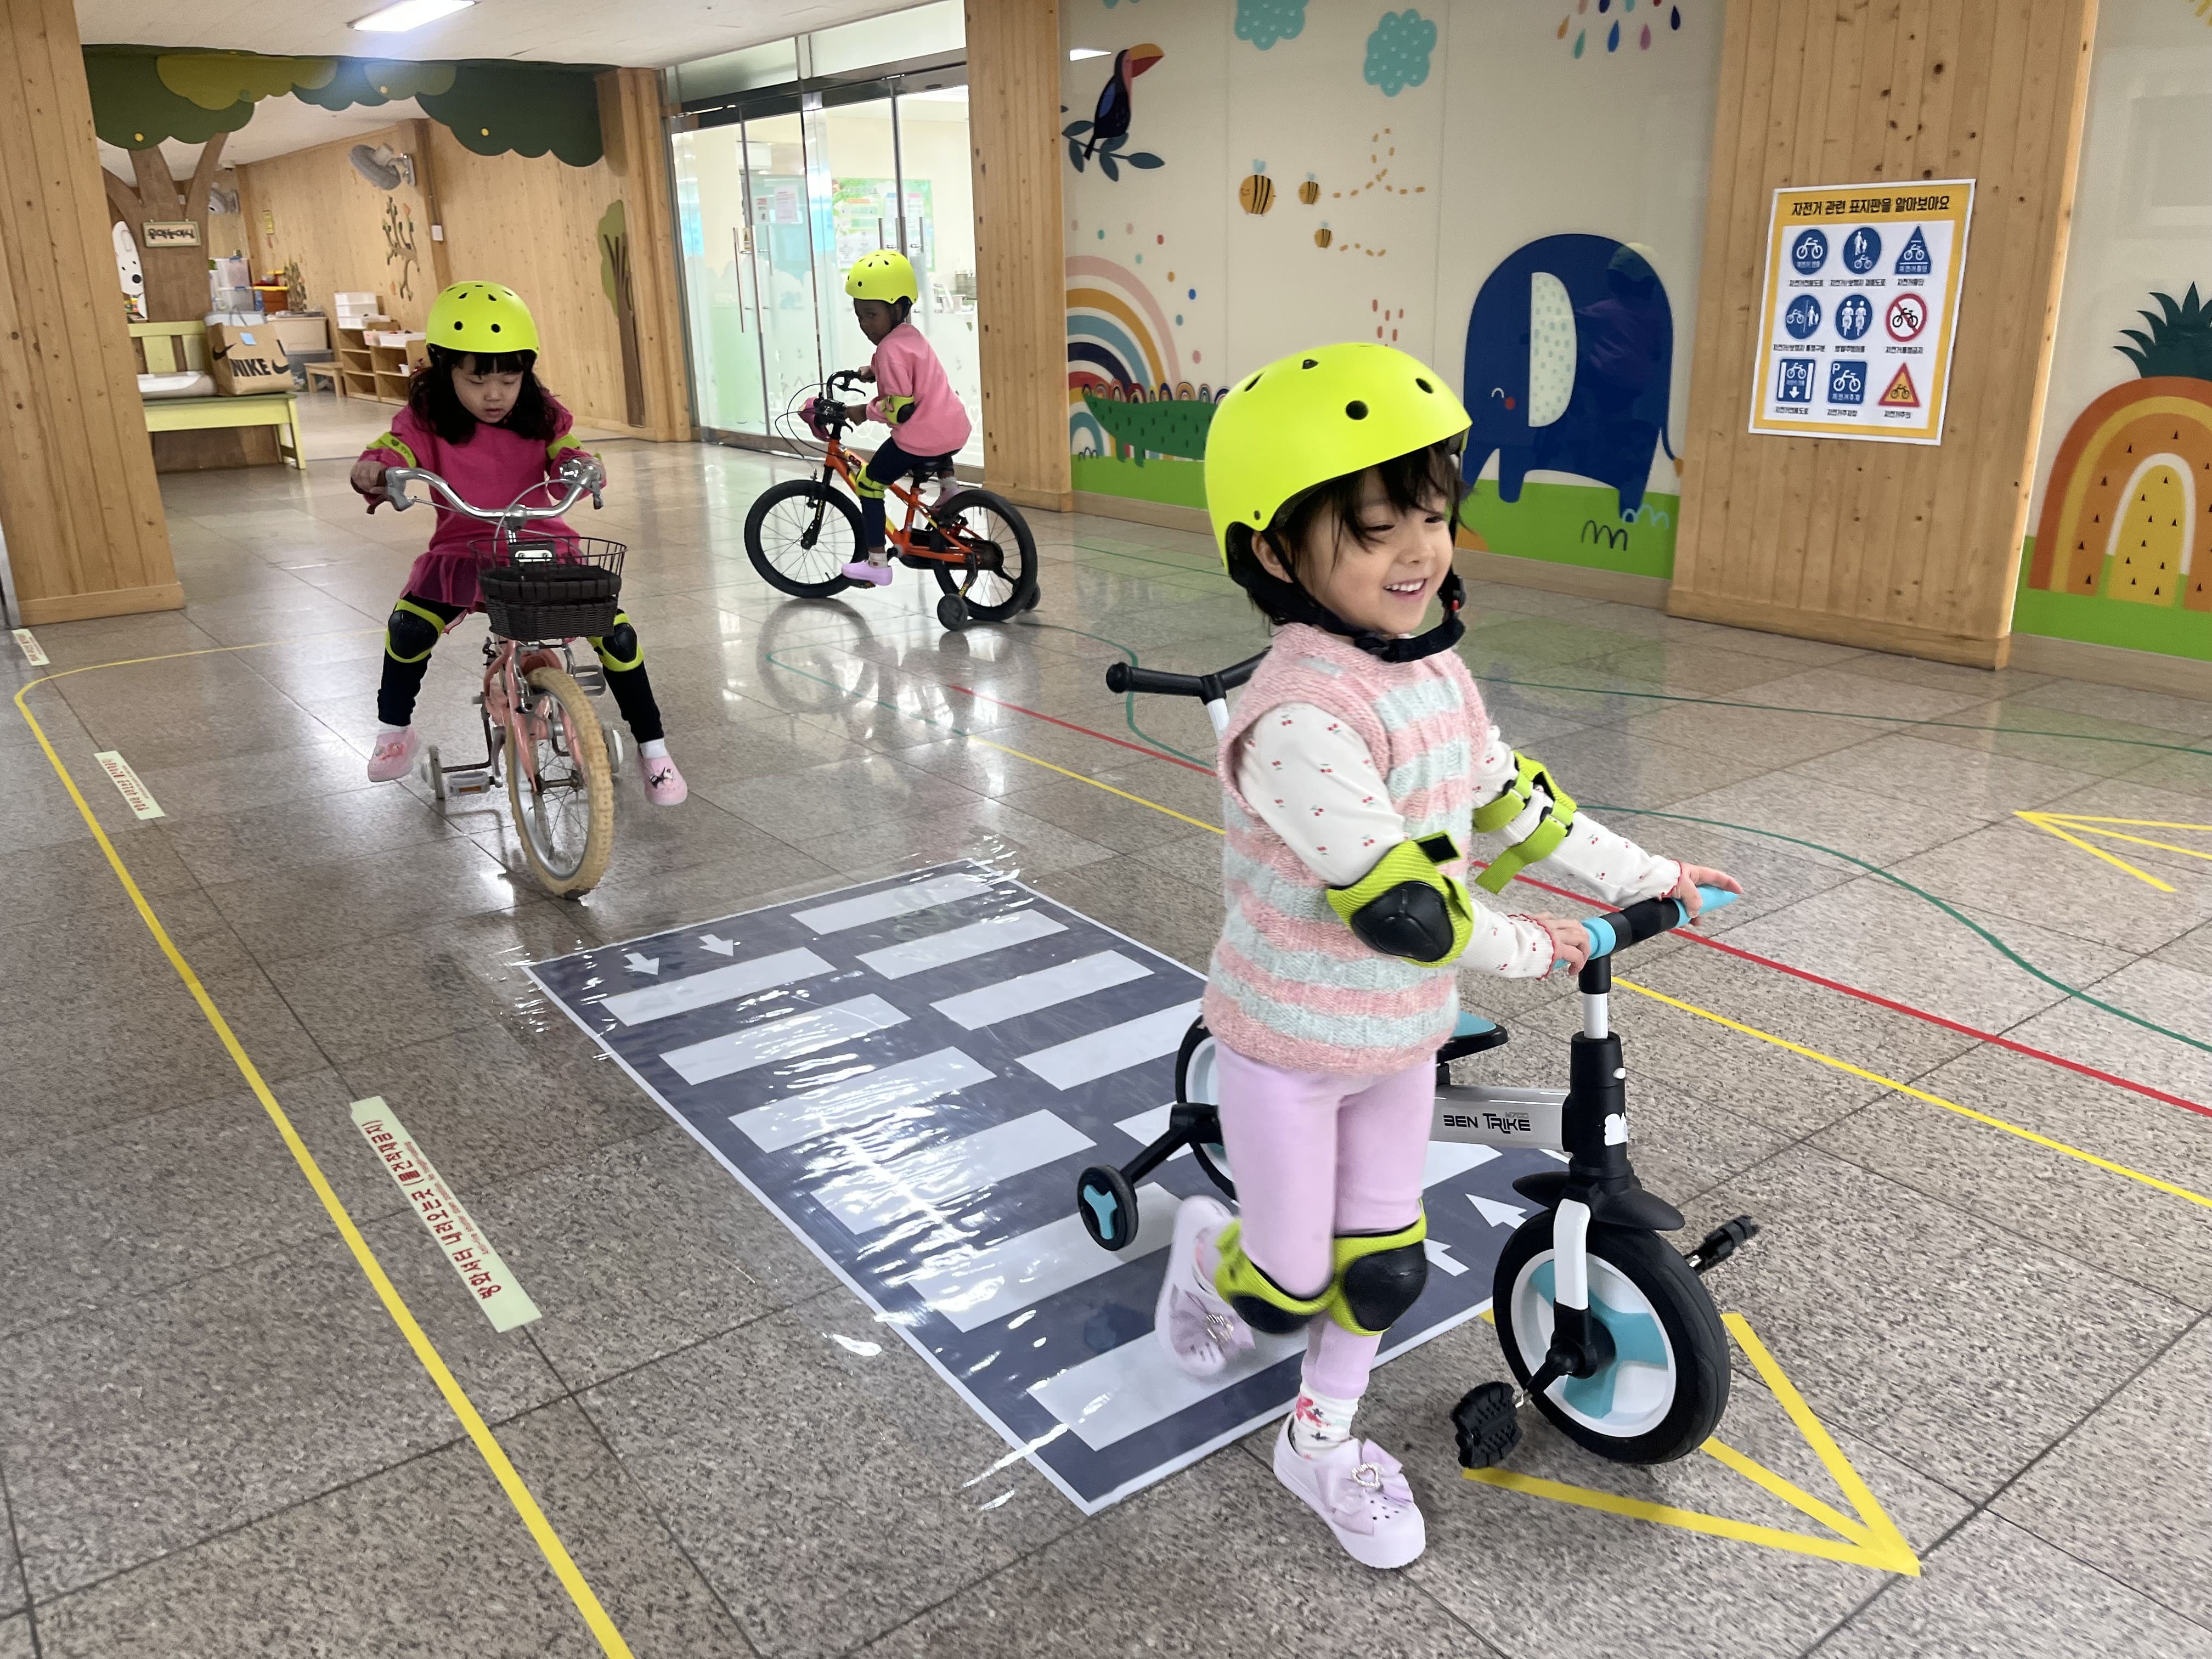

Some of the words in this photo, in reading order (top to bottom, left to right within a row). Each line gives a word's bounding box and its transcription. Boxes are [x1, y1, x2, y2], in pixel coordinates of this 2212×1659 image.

[1792, 201, 1822, 216] 자전거
[1825, 200, 1846, 215] 관련
[1849, 198, 1892, 213] 표지판을
[1895, 195, 1950, 212] 알아보아요
[230, 358, 272, 377] NIKE
[1832, 363, 1840, 374] P
[1482, 1113, 1531, 1134] TRIKE
[411, 1188, 462, 1245] 내려오는곳
[452, 1248, 501, 1299] 방화셔터
